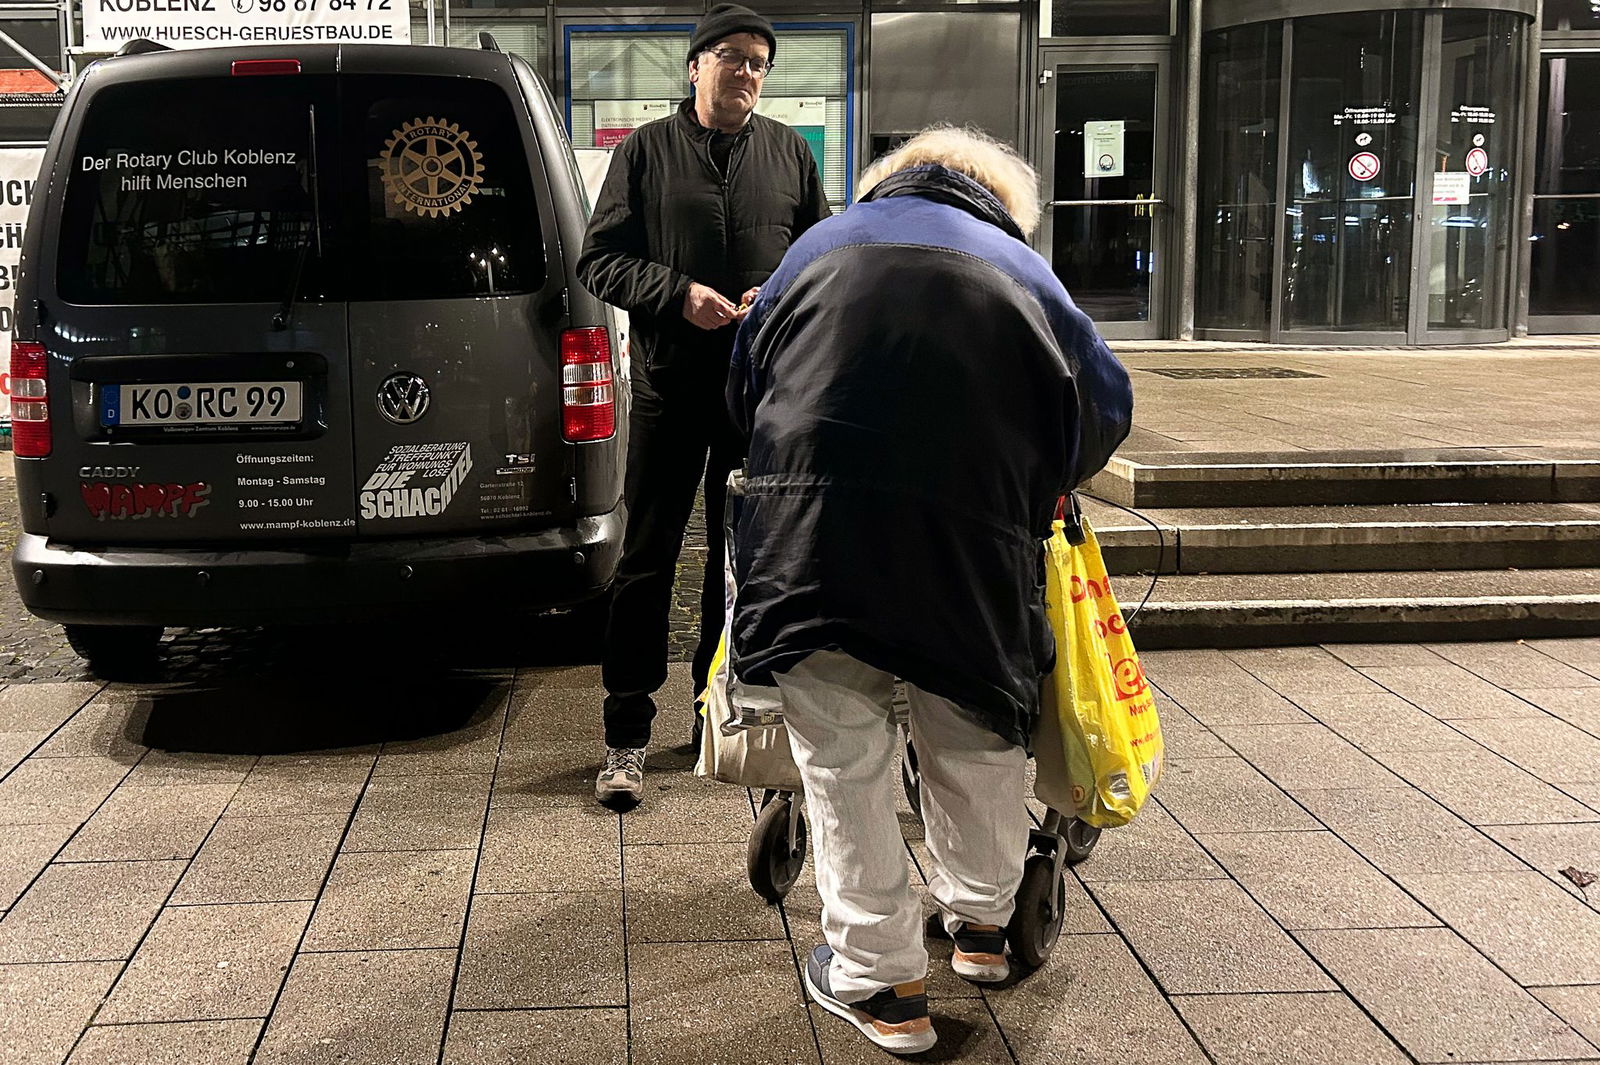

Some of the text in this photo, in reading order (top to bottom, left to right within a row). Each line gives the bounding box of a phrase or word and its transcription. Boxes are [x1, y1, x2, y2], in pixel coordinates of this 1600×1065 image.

[99, 0, 216, 12] KOBLENZ
[101, 25, 393, 41] WWW.HUESCH-GERUESTBAU.DE
[409, 127, 453, 139] ROTARY
[82, 149, 296, 171] Der Rotary Club Koblenz
[121, 173, 247, 191] hilft Menschen
[398, 182, 470, 207] INTERNATIONAL
[132, 386, 286, 420] KO RC 99
[107, 409, 115, 418] D
[389, 442, 467, 455] SOZIALBERATUNG
[236, 453, 314, 465] Öffnungszeiten:
[397, 460, 454, 471] WOHNUNGS-
[79, 466, 141, 478] CADDY
[422, 468, 451, 478] LOSE
[237, 477, 274, 487] Montag
[282, 476, 326, 486] Samstag
[361, 470, 416, 491] DIE
[238, 499, 259, 508] 9.00
[267, 498, 293, 507] 15.00
[296, 498, 314, 507] Uhr
[240, 518, 356, 530] www.mampf-koblenz.de
